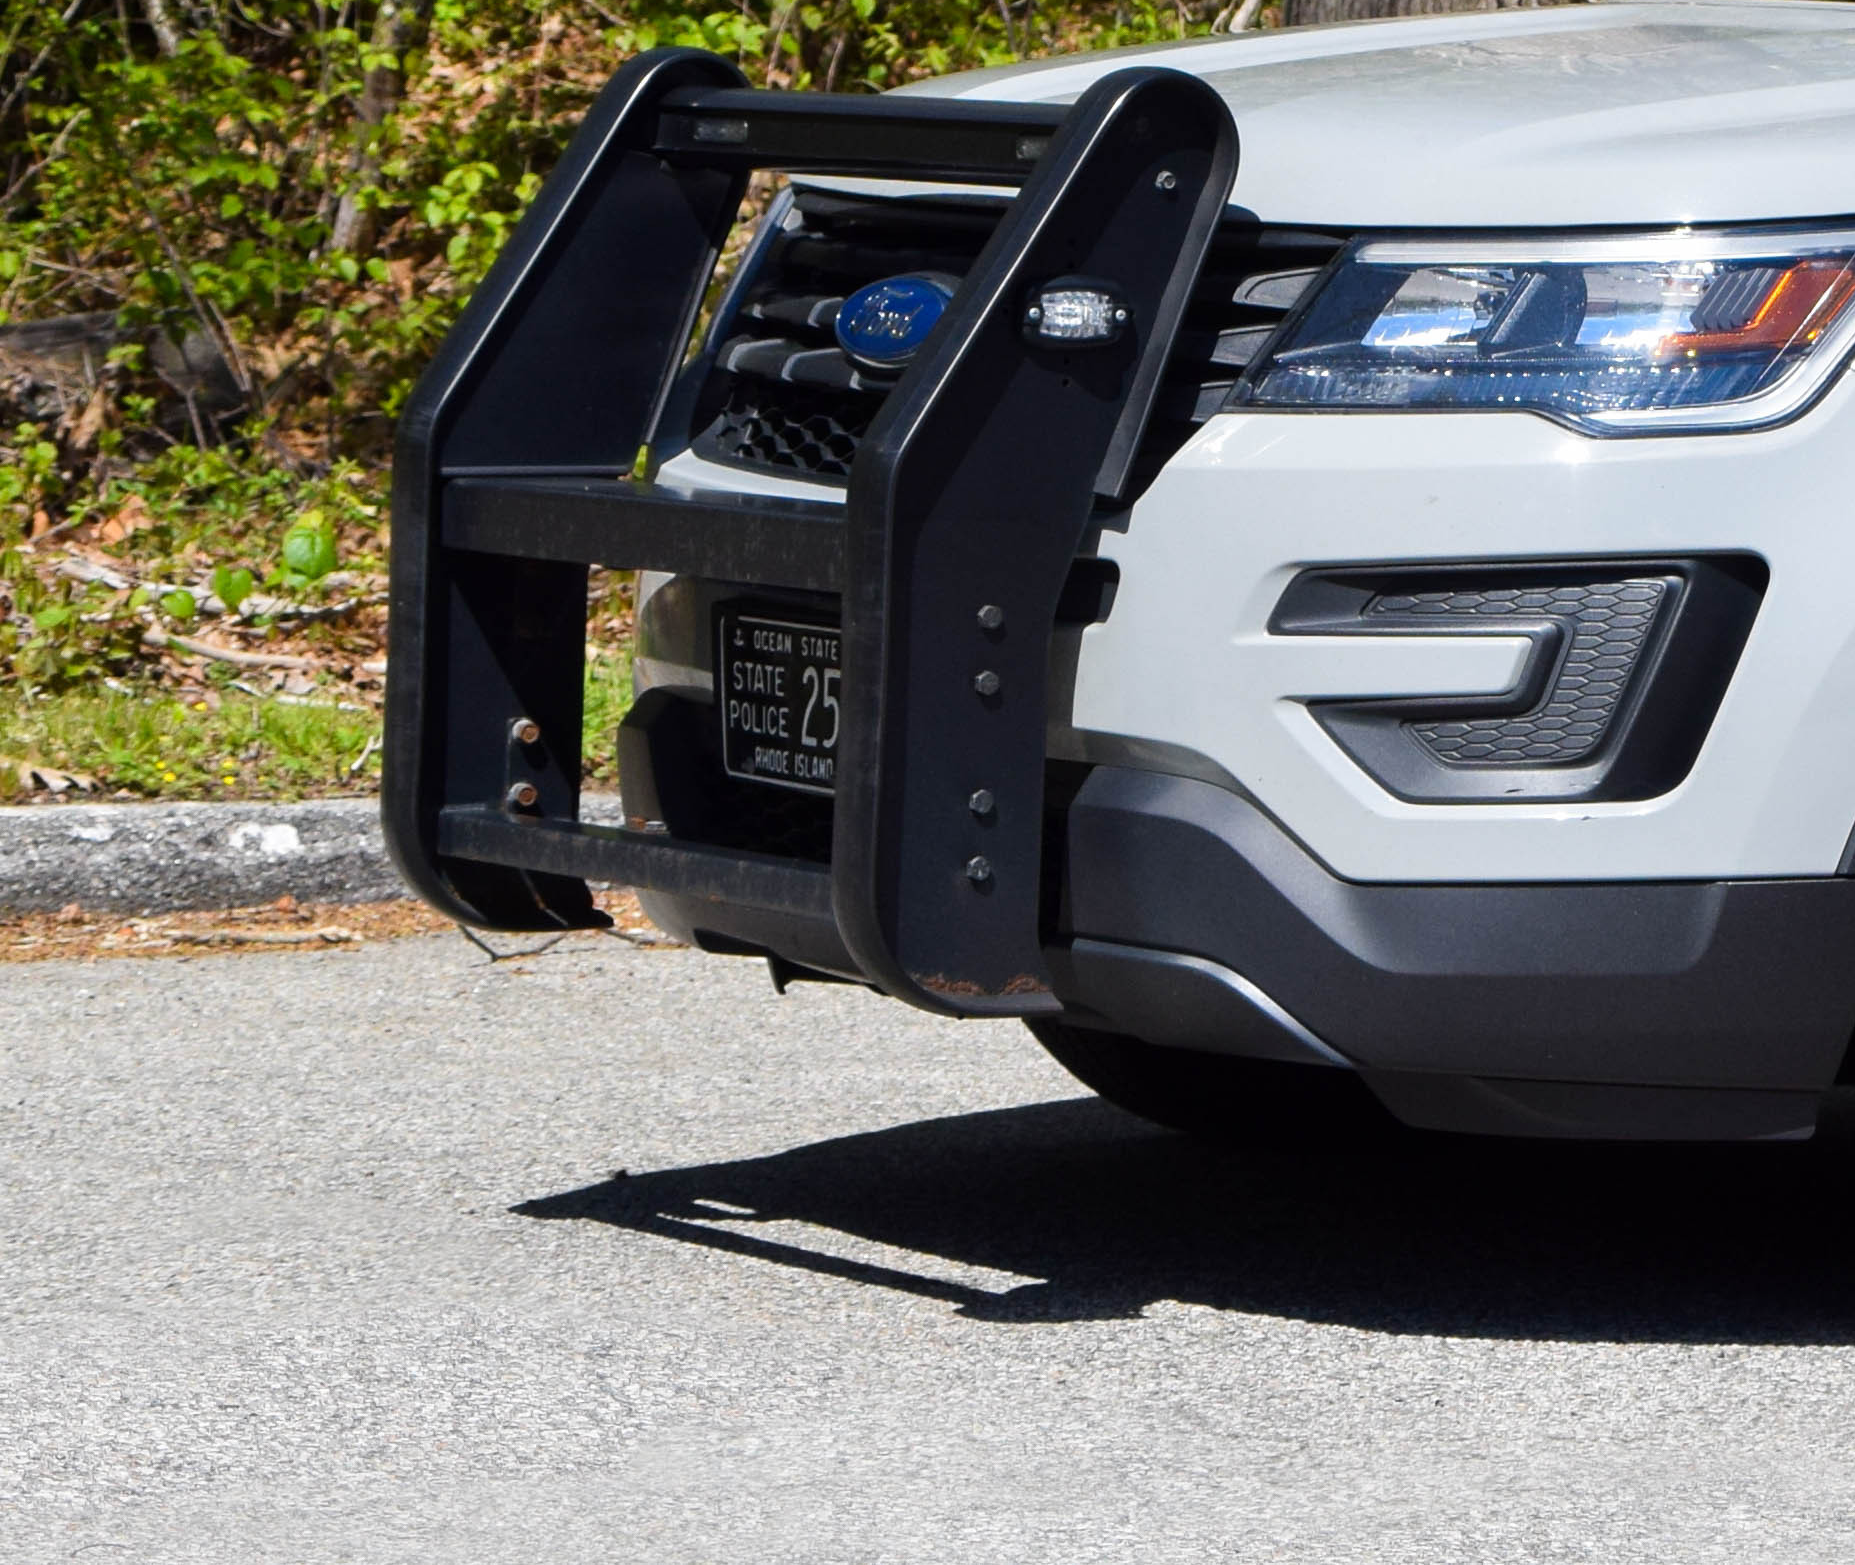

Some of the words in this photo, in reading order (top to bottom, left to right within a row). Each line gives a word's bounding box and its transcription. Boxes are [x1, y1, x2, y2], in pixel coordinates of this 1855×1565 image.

[848, 285, 924, 339] Ford
[753, 629, 792, 654] OCEAN
[801, 637, 839, 661] STATE
[732, 661, 785, 697] STATE
[729, 700, 790, 738] POLICE
[801, 665, 841, 748] 25
[754, 746, 789, 774] RHODE
